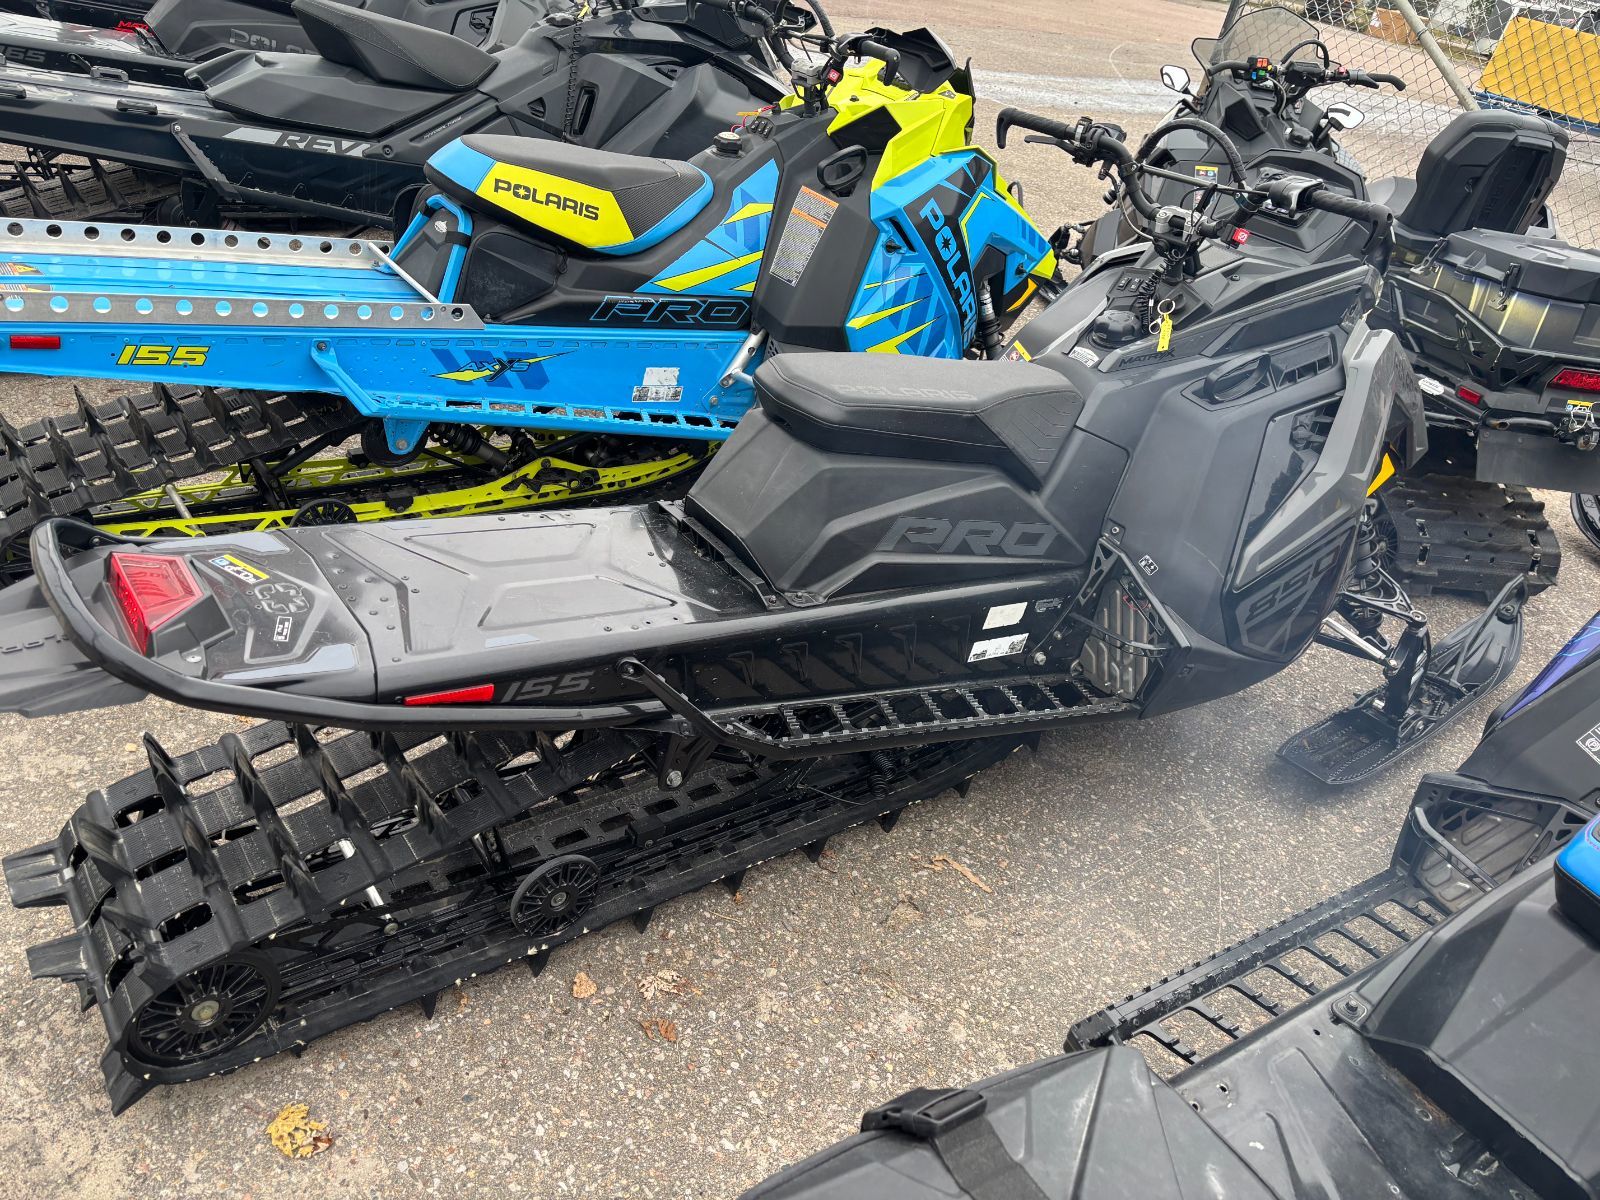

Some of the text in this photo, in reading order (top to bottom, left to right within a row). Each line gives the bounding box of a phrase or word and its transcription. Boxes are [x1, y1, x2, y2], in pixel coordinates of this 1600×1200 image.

[274, 131, 363, 158] REV
[493, 177, 600, 221] POLARIS
[919, 197, 977, 351] POLARIS
[589, 295, 750, 324] PRO
[116, 345, 211, 367] 155
[829, 383, 978, 402] POLARIS
[874, 516, 1059, 556] PRO
[1246, 546, 1341, 623] 850
[499, 670, 595, 704] 155
